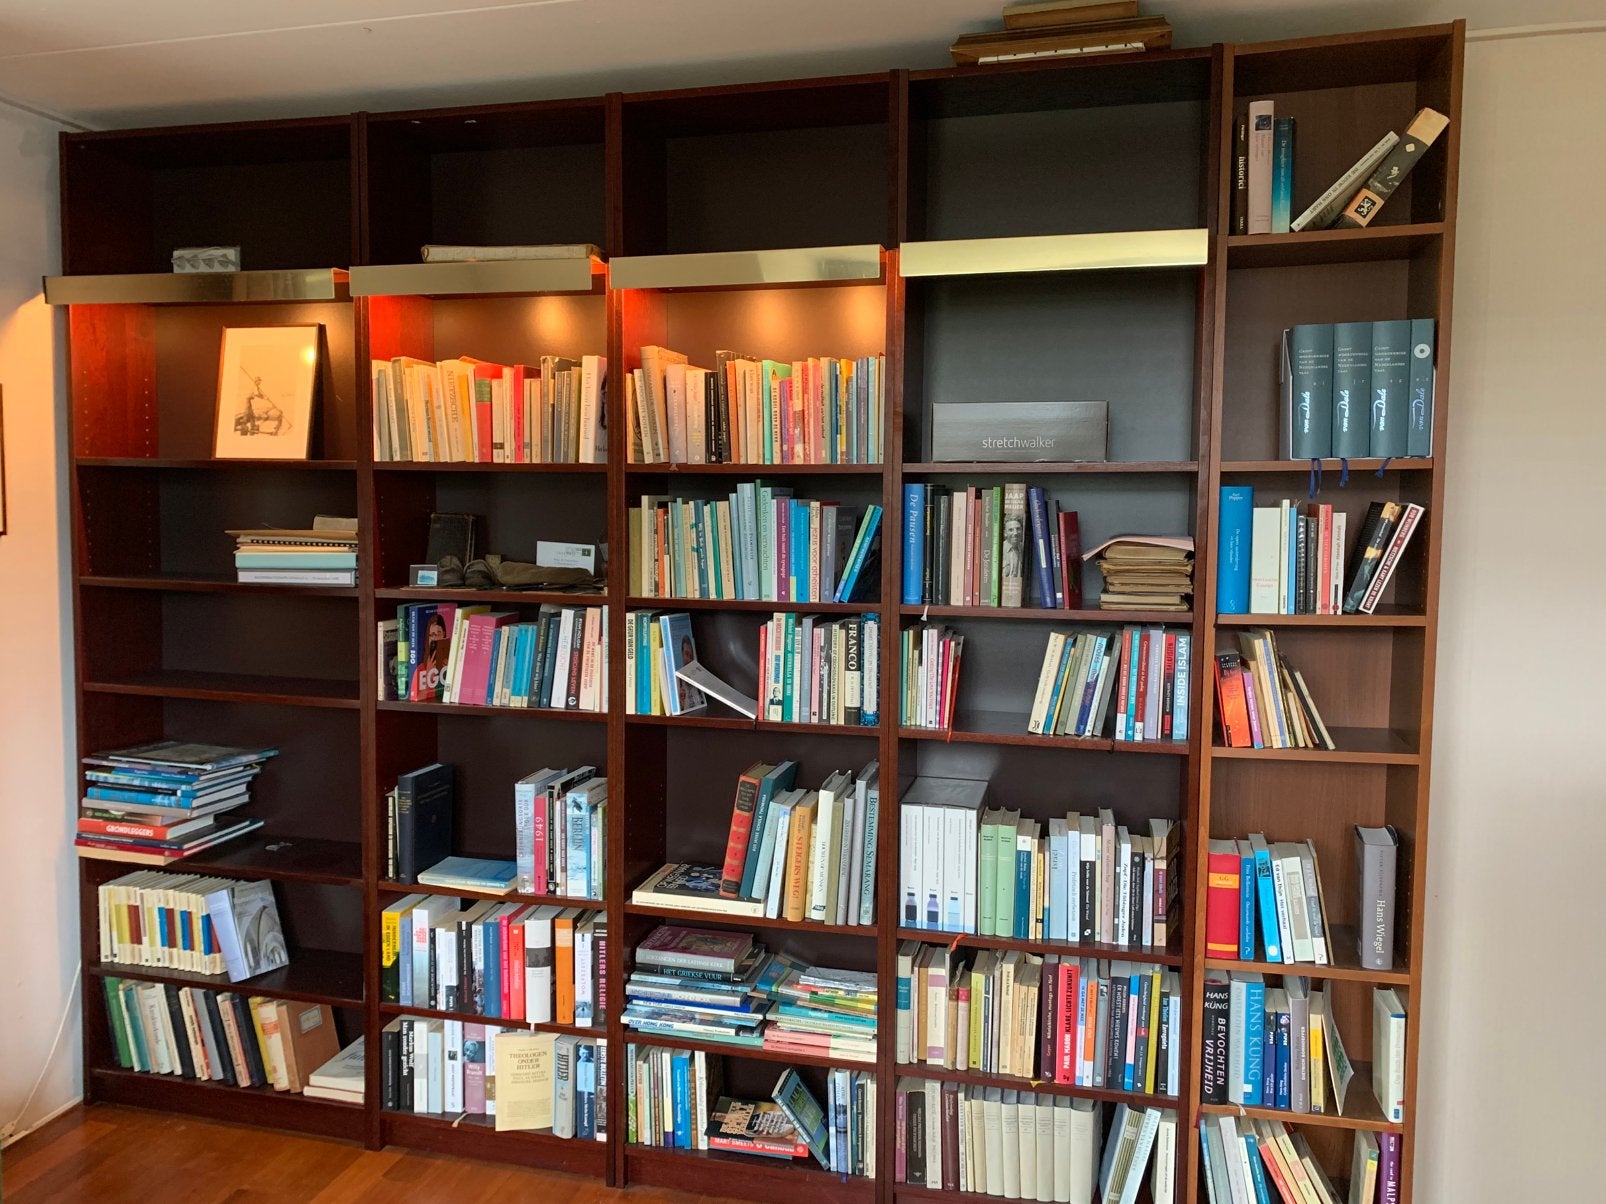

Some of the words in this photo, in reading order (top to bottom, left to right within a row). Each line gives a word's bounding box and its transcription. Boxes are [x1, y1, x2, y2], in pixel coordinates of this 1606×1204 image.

[1238, 156, 1247, 190] historici
[447, 370, 459, 423] NIETZSCHE
[982, 436, 1055, 449] stretchwalker
[761, 490, 770, 523] Gedenken
[909, 493, 919, 506] De
[761, 524, 767, 533] en
[812, 527, 820, 547] jezus
[909, 510, 919, 543] Pausen
[761, 534, 770, 570] verwachten
[1384, 546, 1399, 566] NIETZSCHE
[812, 565, 820, 600] atheisten
[1374, 579, 1384, 590] LEZEN
[1379, 570, 1388, 580] KANT
[1364, 596, 1376, 610] KRANT
[847, 624, 858, 669] FRANCO
[1177, 637, 1187, 670] ISLAM
[1176, 671, 1186, 706] INSIDE
[106, 824, 154, 837] GRONDLEGGERS
[535, 816, 544, 842] 1949
[866, 797, 878, 849] BESTEMMING
[794, 836, 804, 876] STEIGERS
[1275, 864, 1280, 872] Ed
[863, 850, 875, 895] SEMARANG
[792, 877, 802, 899] WEG!
[1376, 900, 1386, 922] Hans
[1373, 924, 1386, 954] Wiegel
[598, 940, 606, 975] HITLERS
[664, 967, 676, 975] HET
[677, 969, 702, 978] GRIEKSE
[704, 971, 722, 980] VUUR
[598, 978, 606, 1010] RELIGIE
[1204, 1000, 1229, 1010] KÜNG
[1206, 991, 1229, 999] HANS
[1248, 989, 1262, 1031] HANS
[643, 1020, 658, 1028] HONG
[510, 1051, 547, 1059] THEOLOGEN
[1216, 1017, 1227, 1085] BEVOCHTEN
[1247, 1036, 1263, 1081] KÜNG
[557, 1053, 569, 1081] HITLER
[599, 1063, 607, 1086] BULLETIN
[1204, 1039, 1214, 1094] VRIJHEID
[714, 1136, 730, 1144] MART
[732, 1139, 754, 1148] SMEETS
